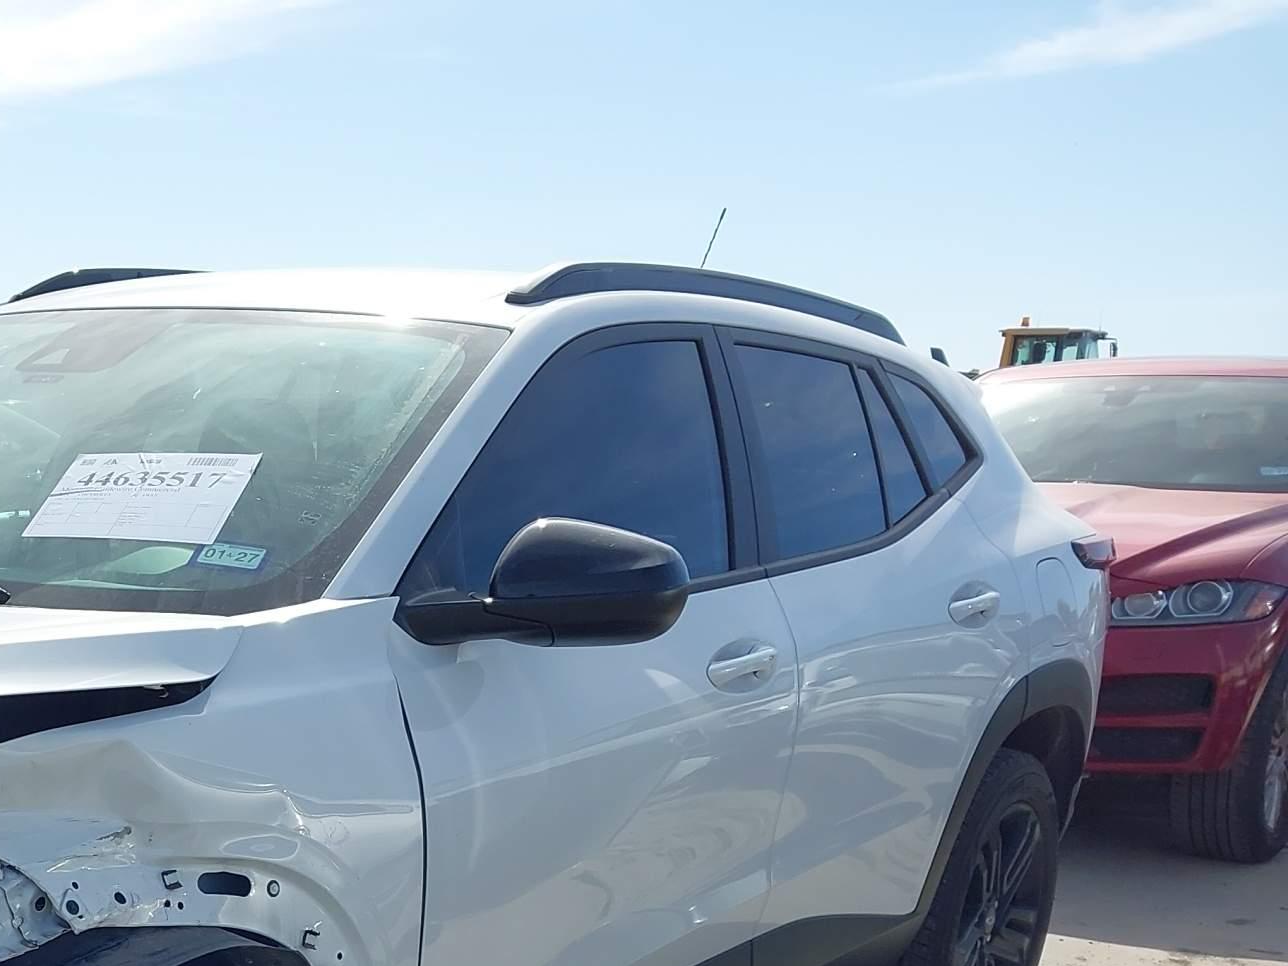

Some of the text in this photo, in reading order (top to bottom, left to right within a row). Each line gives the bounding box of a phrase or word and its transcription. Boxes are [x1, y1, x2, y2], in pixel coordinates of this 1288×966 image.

[77, 471, 226, 489] 44635517
[204, 548, 261, 563] 01 27
